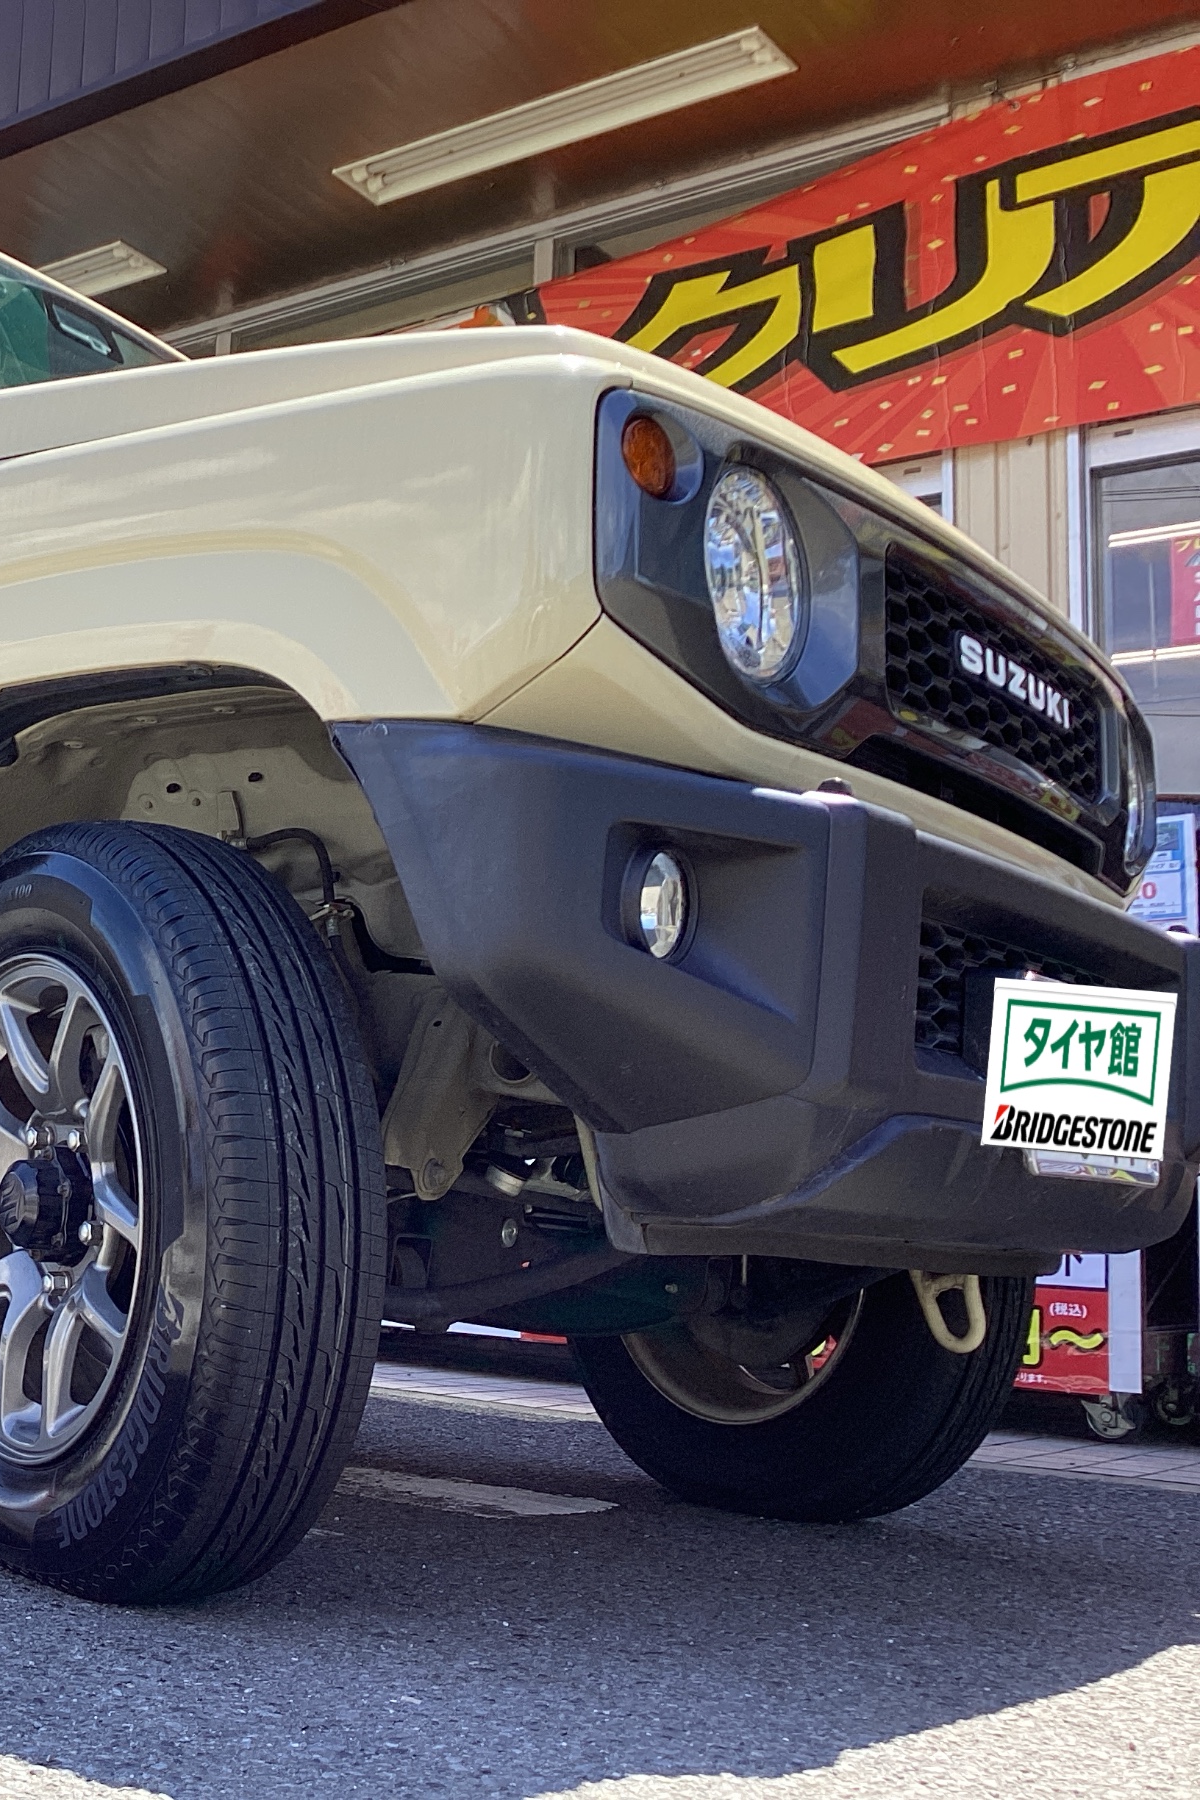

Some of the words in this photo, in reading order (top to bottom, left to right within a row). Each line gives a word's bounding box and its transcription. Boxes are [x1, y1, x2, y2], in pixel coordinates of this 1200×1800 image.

[622, 118, 1200, 390] クリア
[959, 633, 1070, 729] SUZUKI
[1049, 1302, 1088, 1319] (税込)
[55, 1282, 184, 1549] BRIDGESTONE
